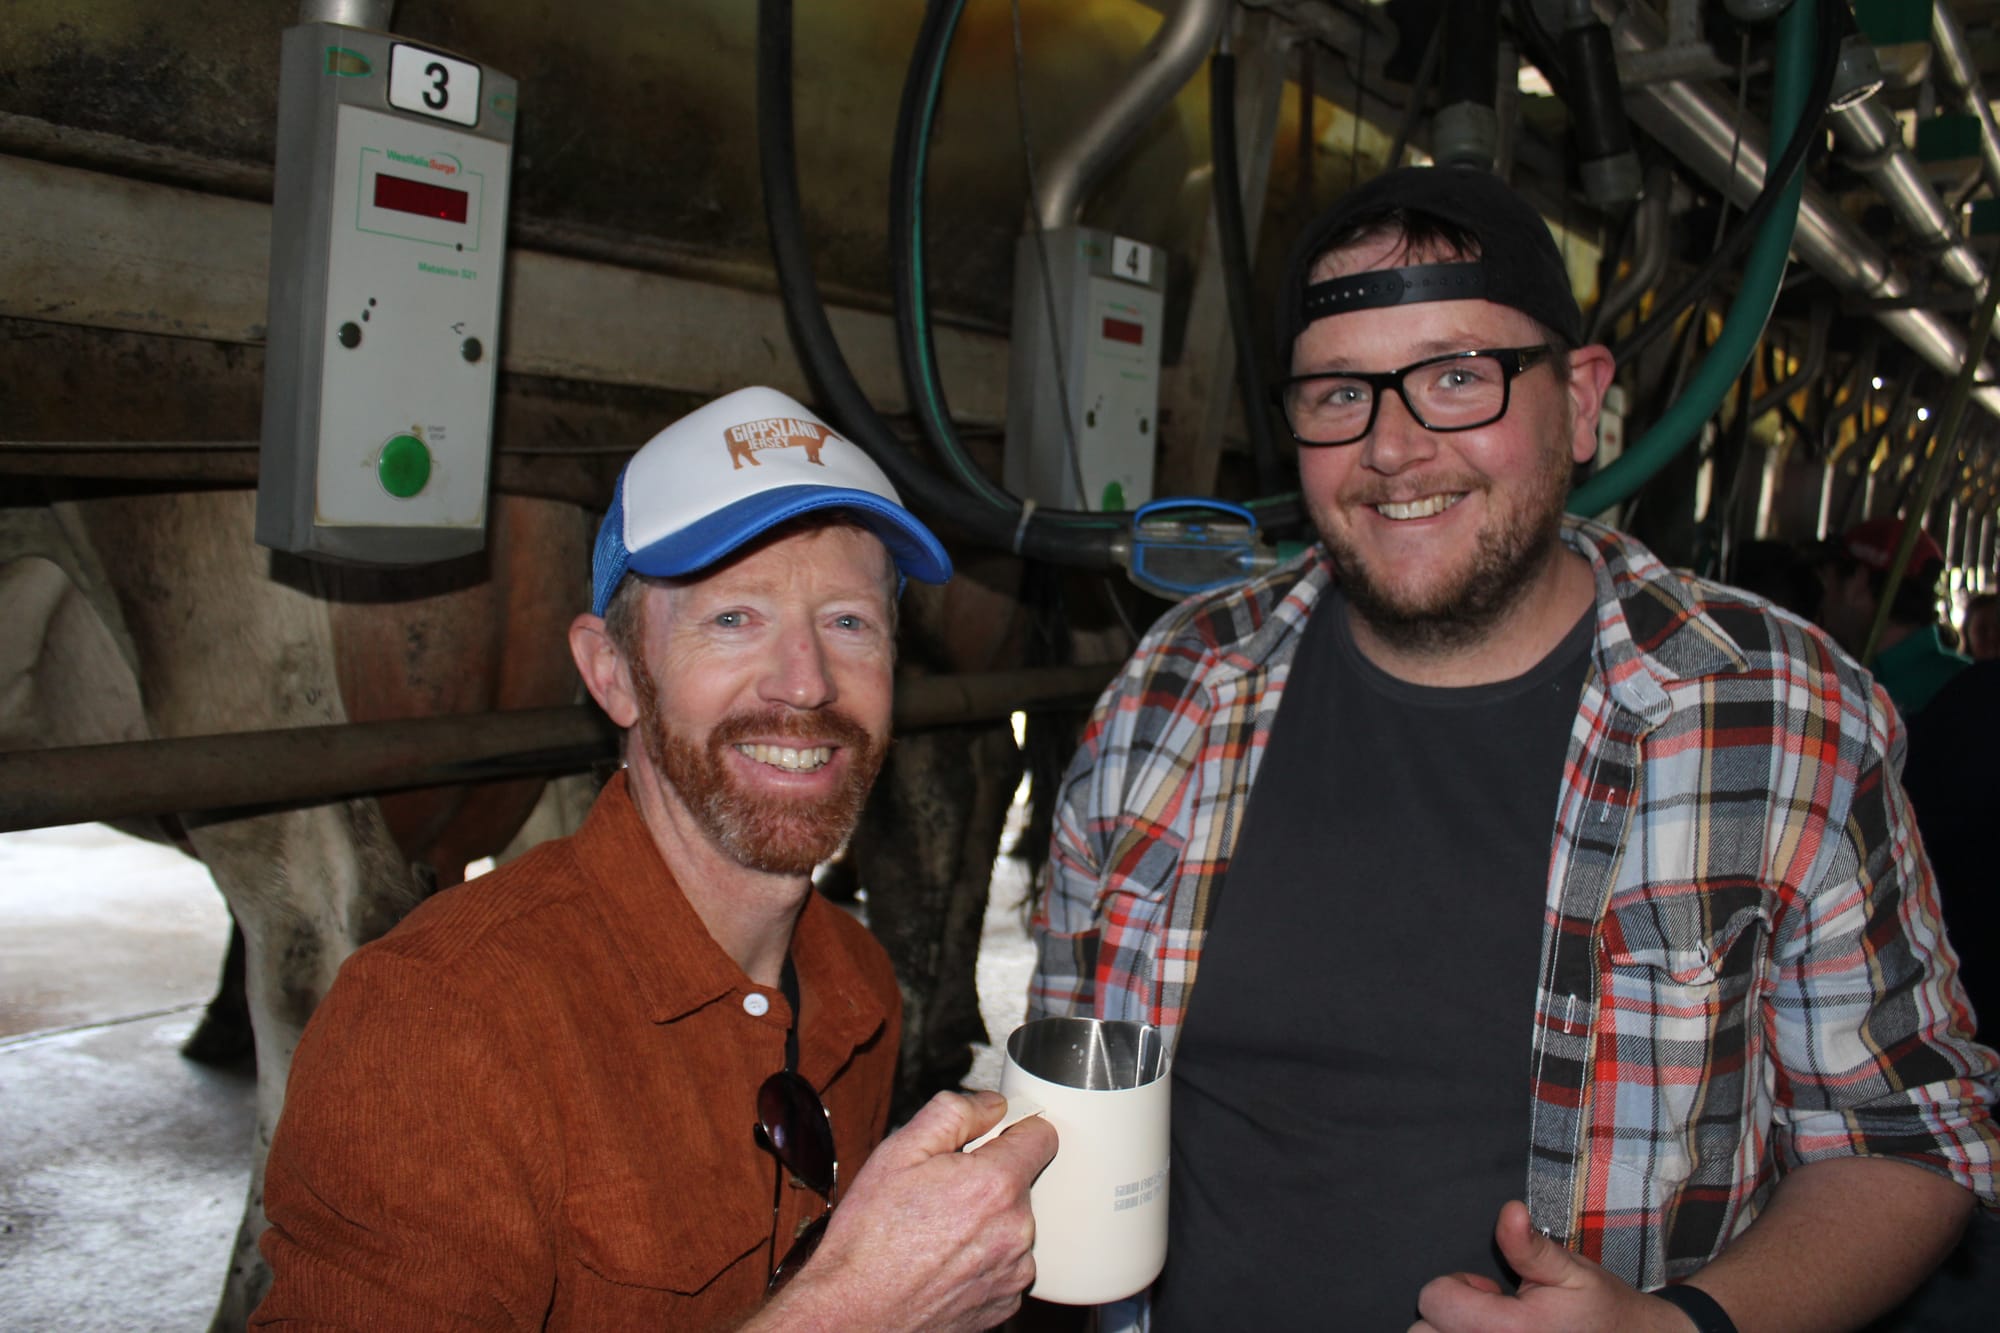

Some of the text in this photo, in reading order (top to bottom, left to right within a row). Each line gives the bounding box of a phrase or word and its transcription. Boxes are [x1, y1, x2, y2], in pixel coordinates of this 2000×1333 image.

[422, 62, 449, 110] 3
[1125, 246, 1139, 275] 4
[731, 419, 820, 443] GIPPSLAND
[748, 436, 790, 451] JERSEY
